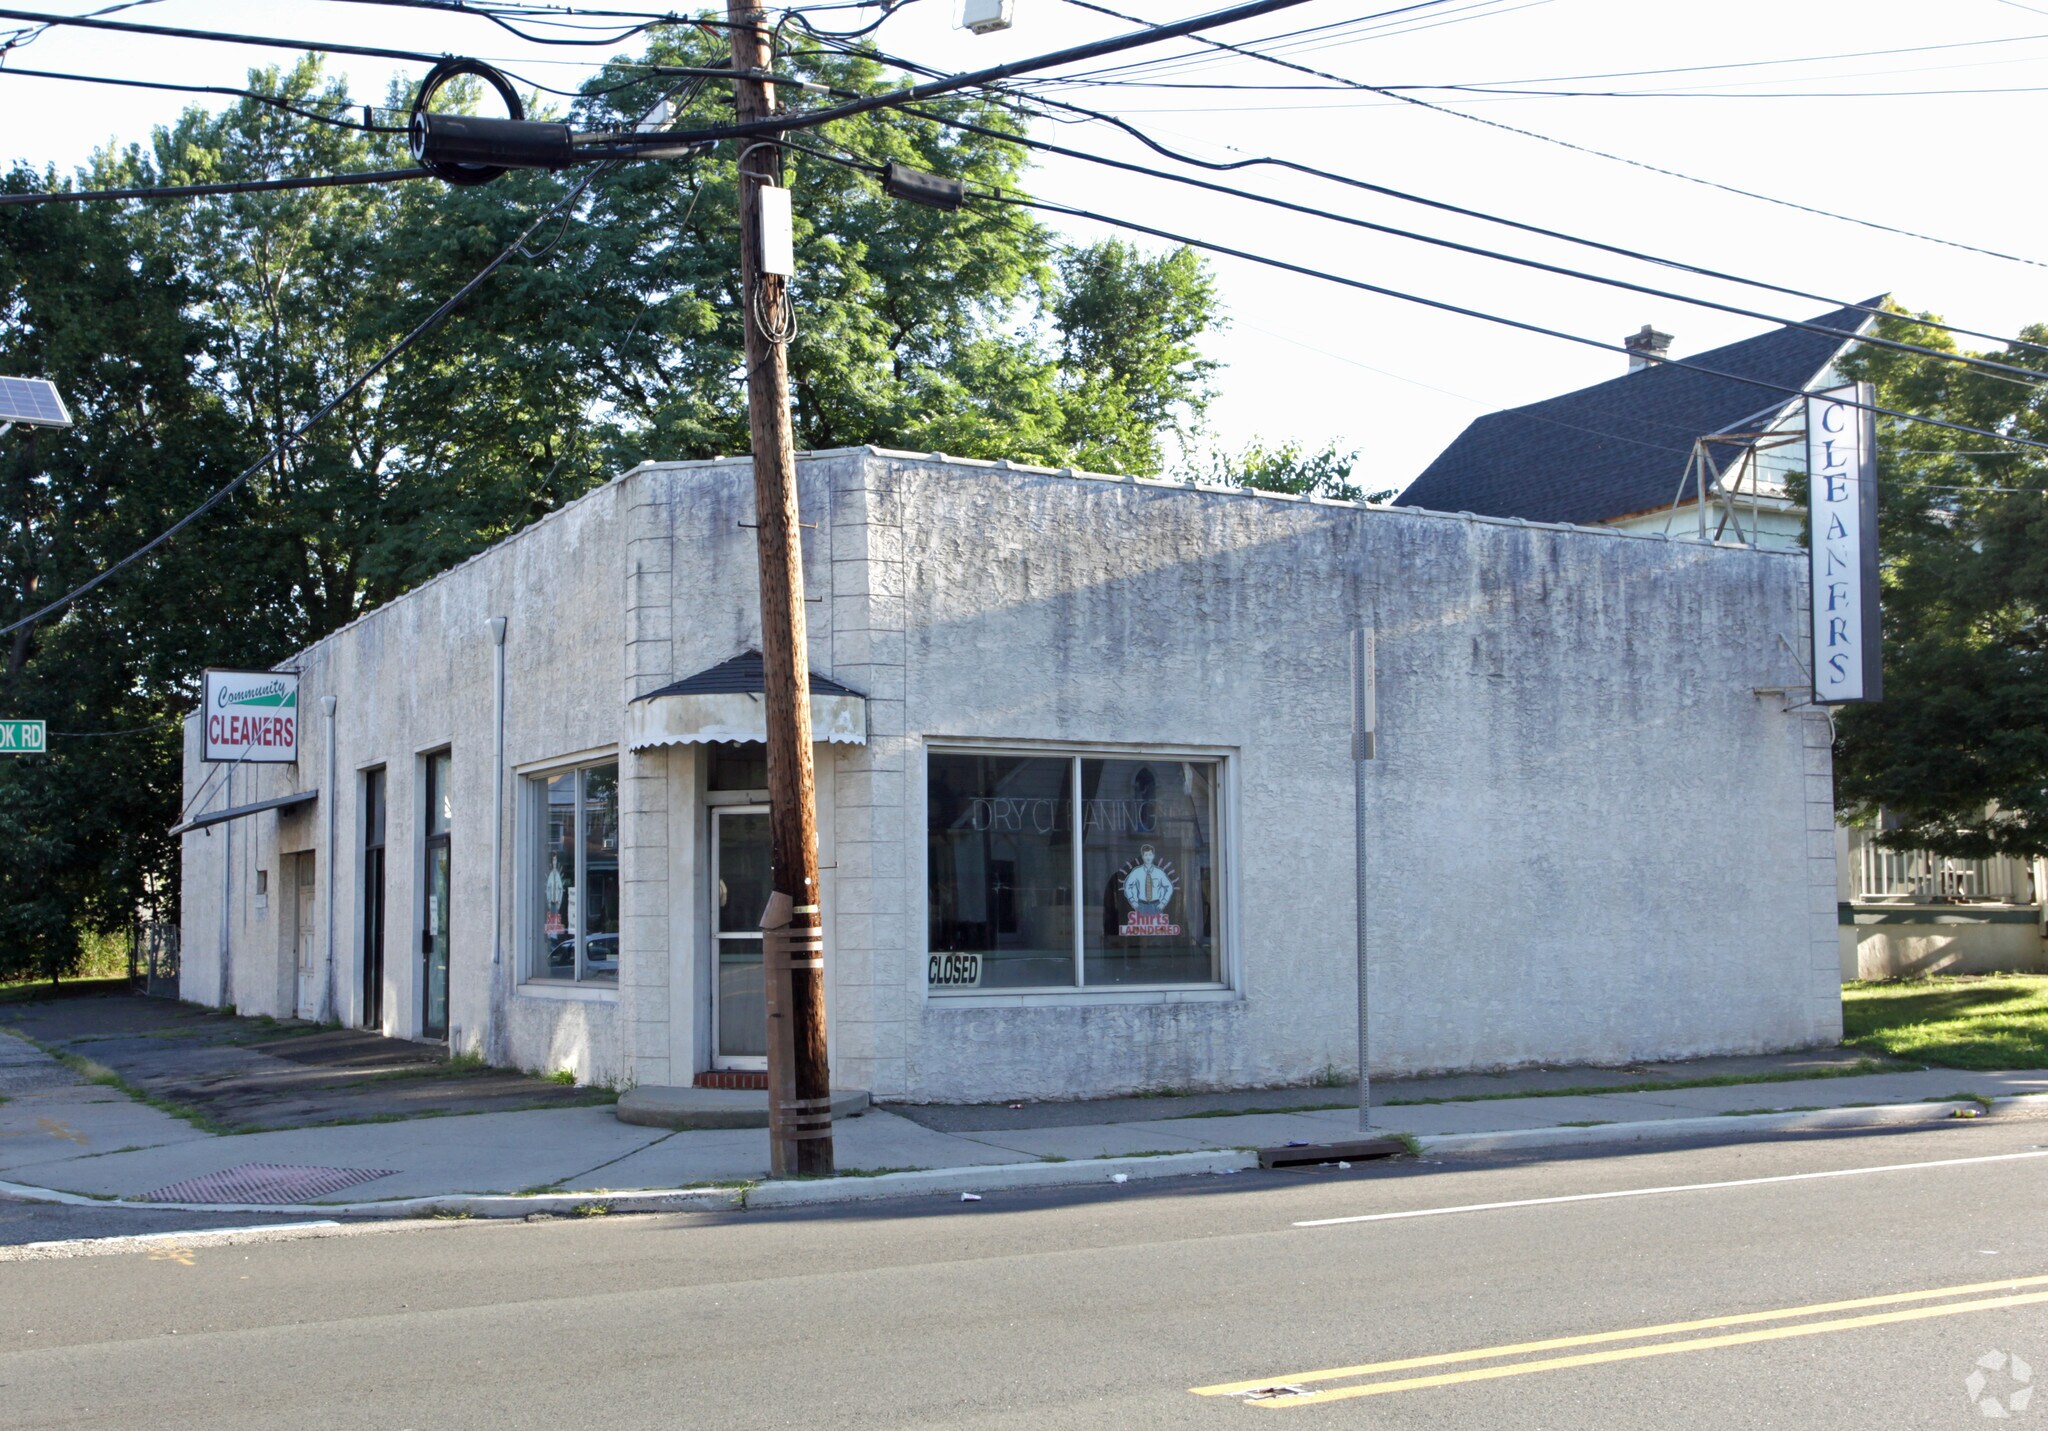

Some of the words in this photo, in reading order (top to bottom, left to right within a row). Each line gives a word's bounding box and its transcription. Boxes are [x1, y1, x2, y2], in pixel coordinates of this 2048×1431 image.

[1821, 402, 1851, 684] CLEANERS
[217, 680, 287, 709] Community
[21, 724, 42, 748] RD
[208, 714, 294, 748] CLEANERS
[973, 799, 1024, 831] DRY
[1119, 925, 1181, 936] LAUNDERED
[1128, 911, 1169, 925] Shirts
[928, 955, 978, 984] CLOSED
